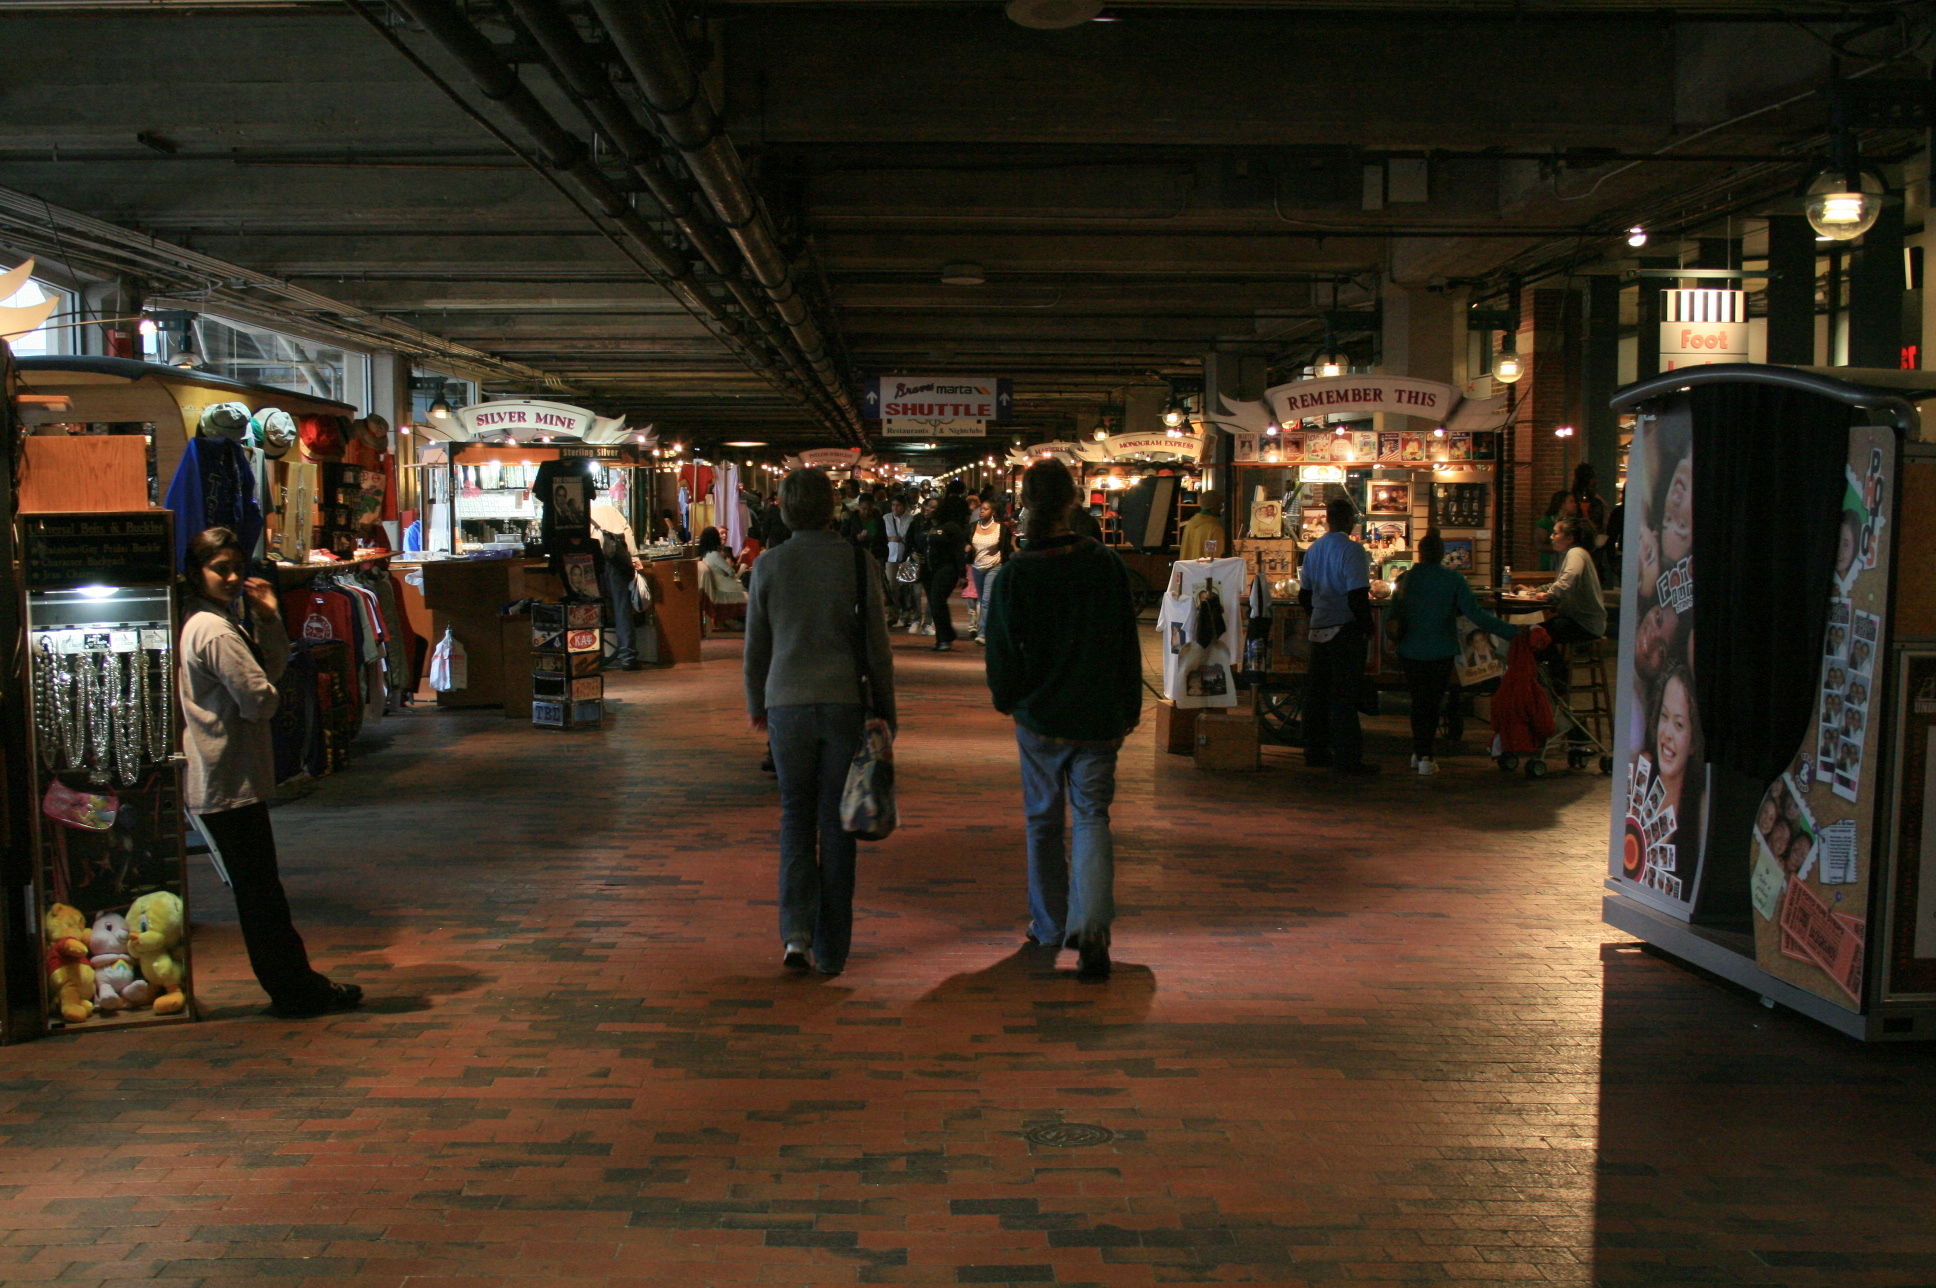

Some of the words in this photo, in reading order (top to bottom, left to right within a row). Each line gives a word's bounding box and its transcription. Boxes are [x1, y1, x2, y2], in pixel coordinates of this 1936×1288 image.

[1681, 329, 1728, 349] Foot
[894, 382, 935, 399] Braves
[936, 385, 972, 395] marta
[1287, 388, 1384, 411] REMEMBER
[1395, 389, 1436, 408] THIS
[885, 403, 992, 417] SHUTTLE
[476, 411, 527, 426] SILVER
[535, 413, 576, 430] MINE
[1119, 440, 1162, 449] MONOGRAM
[1165, 440, 1194, 449] EXPRESS
[563, 448, 594, 458] Sterling
[596, 448, 619, 457] Silver
[125, 521, 163, 534] Buckles
